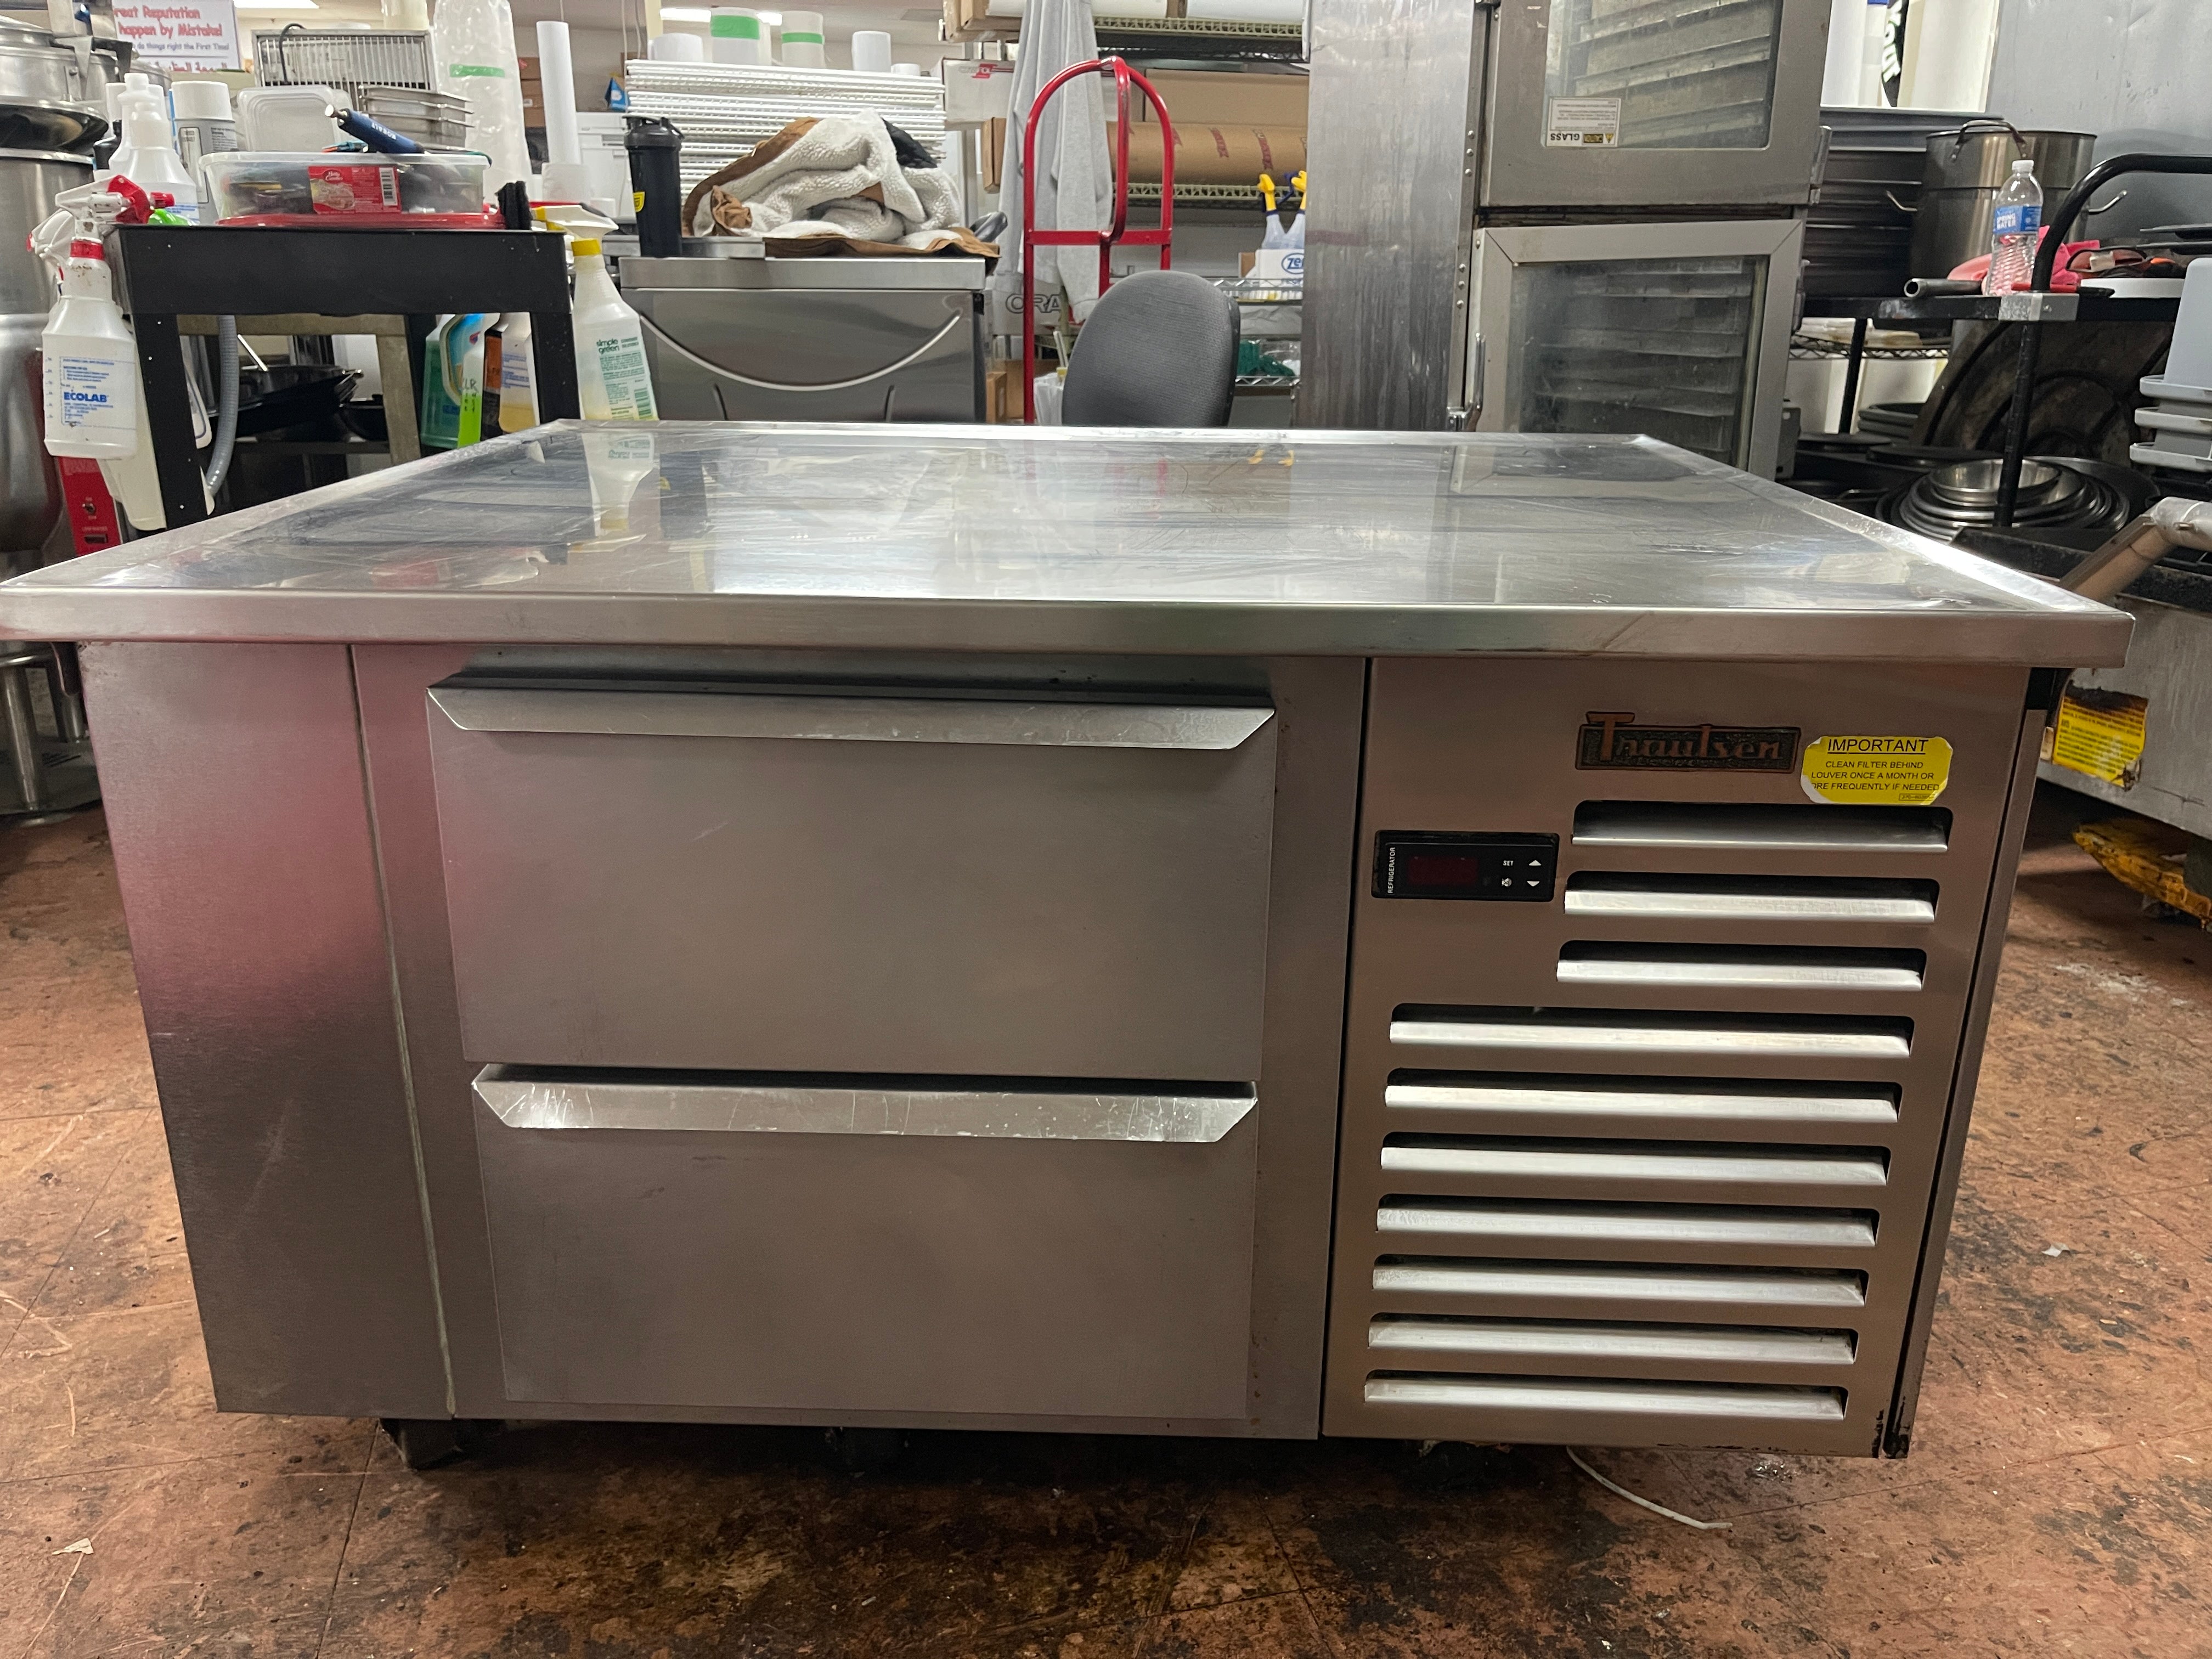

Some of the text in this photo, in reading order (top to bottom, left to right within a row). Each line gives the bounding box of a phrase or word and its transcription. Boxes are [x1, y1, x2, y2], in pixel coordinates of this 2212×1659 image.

[114, 5, 200, 21] reat Reputation
[118, 21, 156, 39] happen
[159, 21, 173, 39] by
[1287, 258, 1304, 269] Ze
[596, 338, 618, 347] simple
[599, 346, 619, 354] green
[462, 377, 479, 392] LR
[64, 392, 108, 403] ECOLAB
[1587, 713, 1780, 761] Traulsen
[1827, 738, 1929, 752] IMPORTANT
[1387, 847, 1396, 894] REFRIGERATOR
